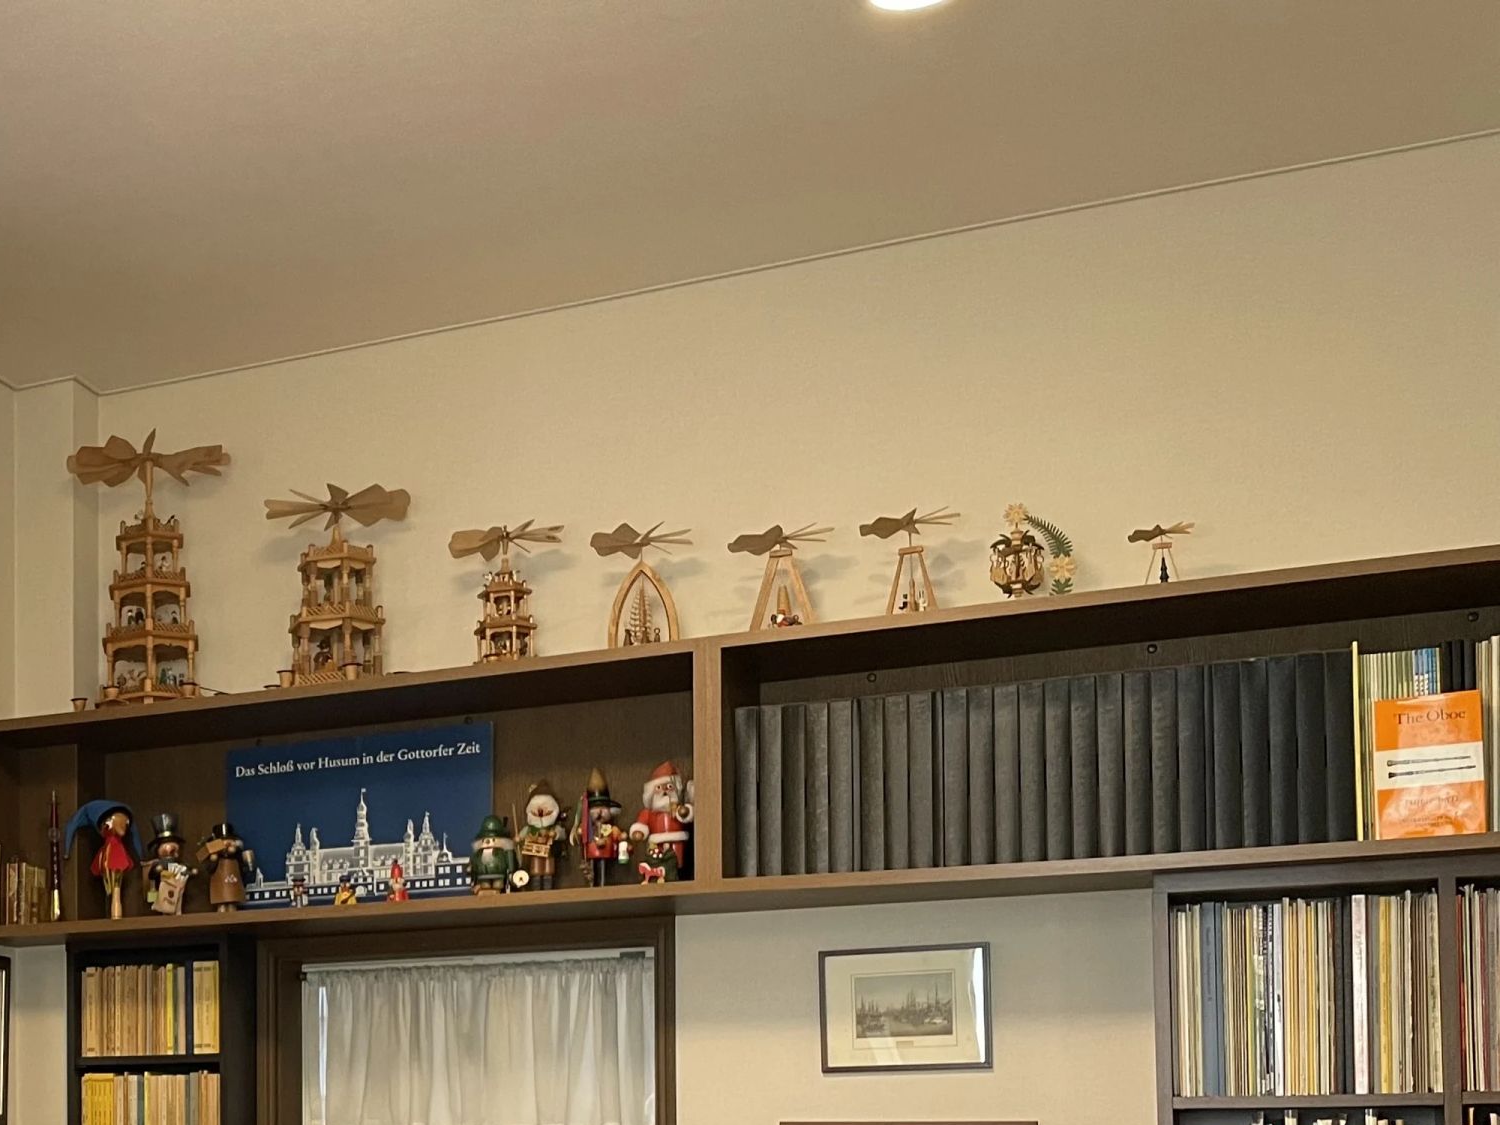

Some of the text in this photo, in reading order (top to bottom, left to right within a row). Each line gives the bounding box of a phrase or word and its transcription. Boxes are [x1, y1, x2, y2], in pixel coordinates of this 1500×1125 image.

[1392, 708, 1466, 725] The Oboe
[235, 741, 481, 778] Das Schloß vor Husum in der Gottorfer Zeit
